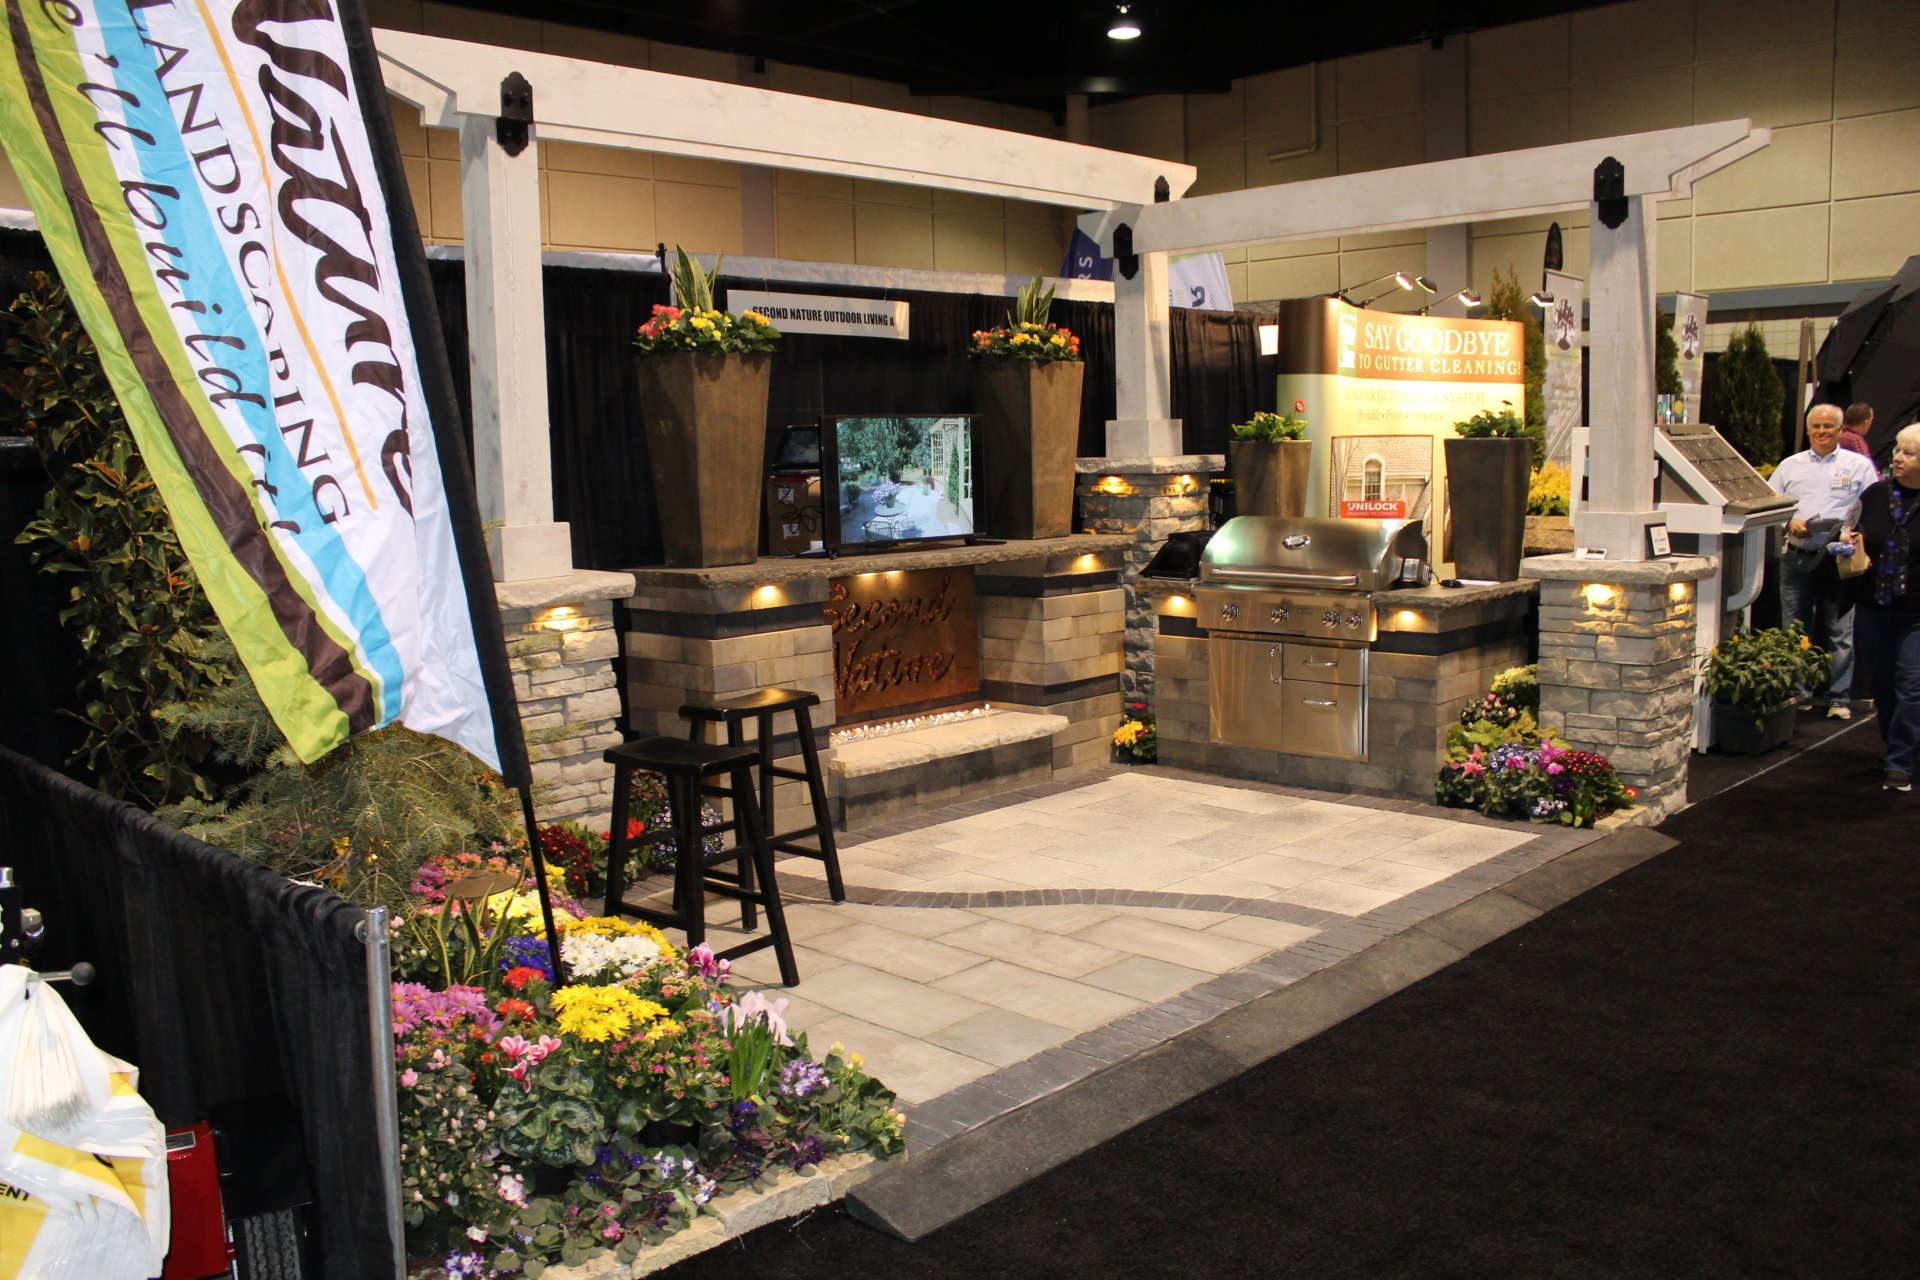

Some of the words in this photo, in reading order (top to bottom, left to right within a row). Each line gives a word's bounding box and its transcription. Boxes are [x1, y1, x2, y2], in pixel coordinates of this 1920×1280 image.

[120, 180, 267, 410] build
[790, 308, 822, 322] NATURE
[824, 310, 862, 324] OUTDOOR
[863, 313, 888, 326] LIVING
[889, 317, 895, 326] &
[1364, 322, 1394, 351] SAY
[1395, 327, 1511, 357] GOODBYE
[1358, 353, 1371, 370] TO
[1375, 355, 1424, 373] GUTTER
[1429, 357, 1521, 376] CLEANING!
[1347, 502, 1398, 511] UNILOCK
